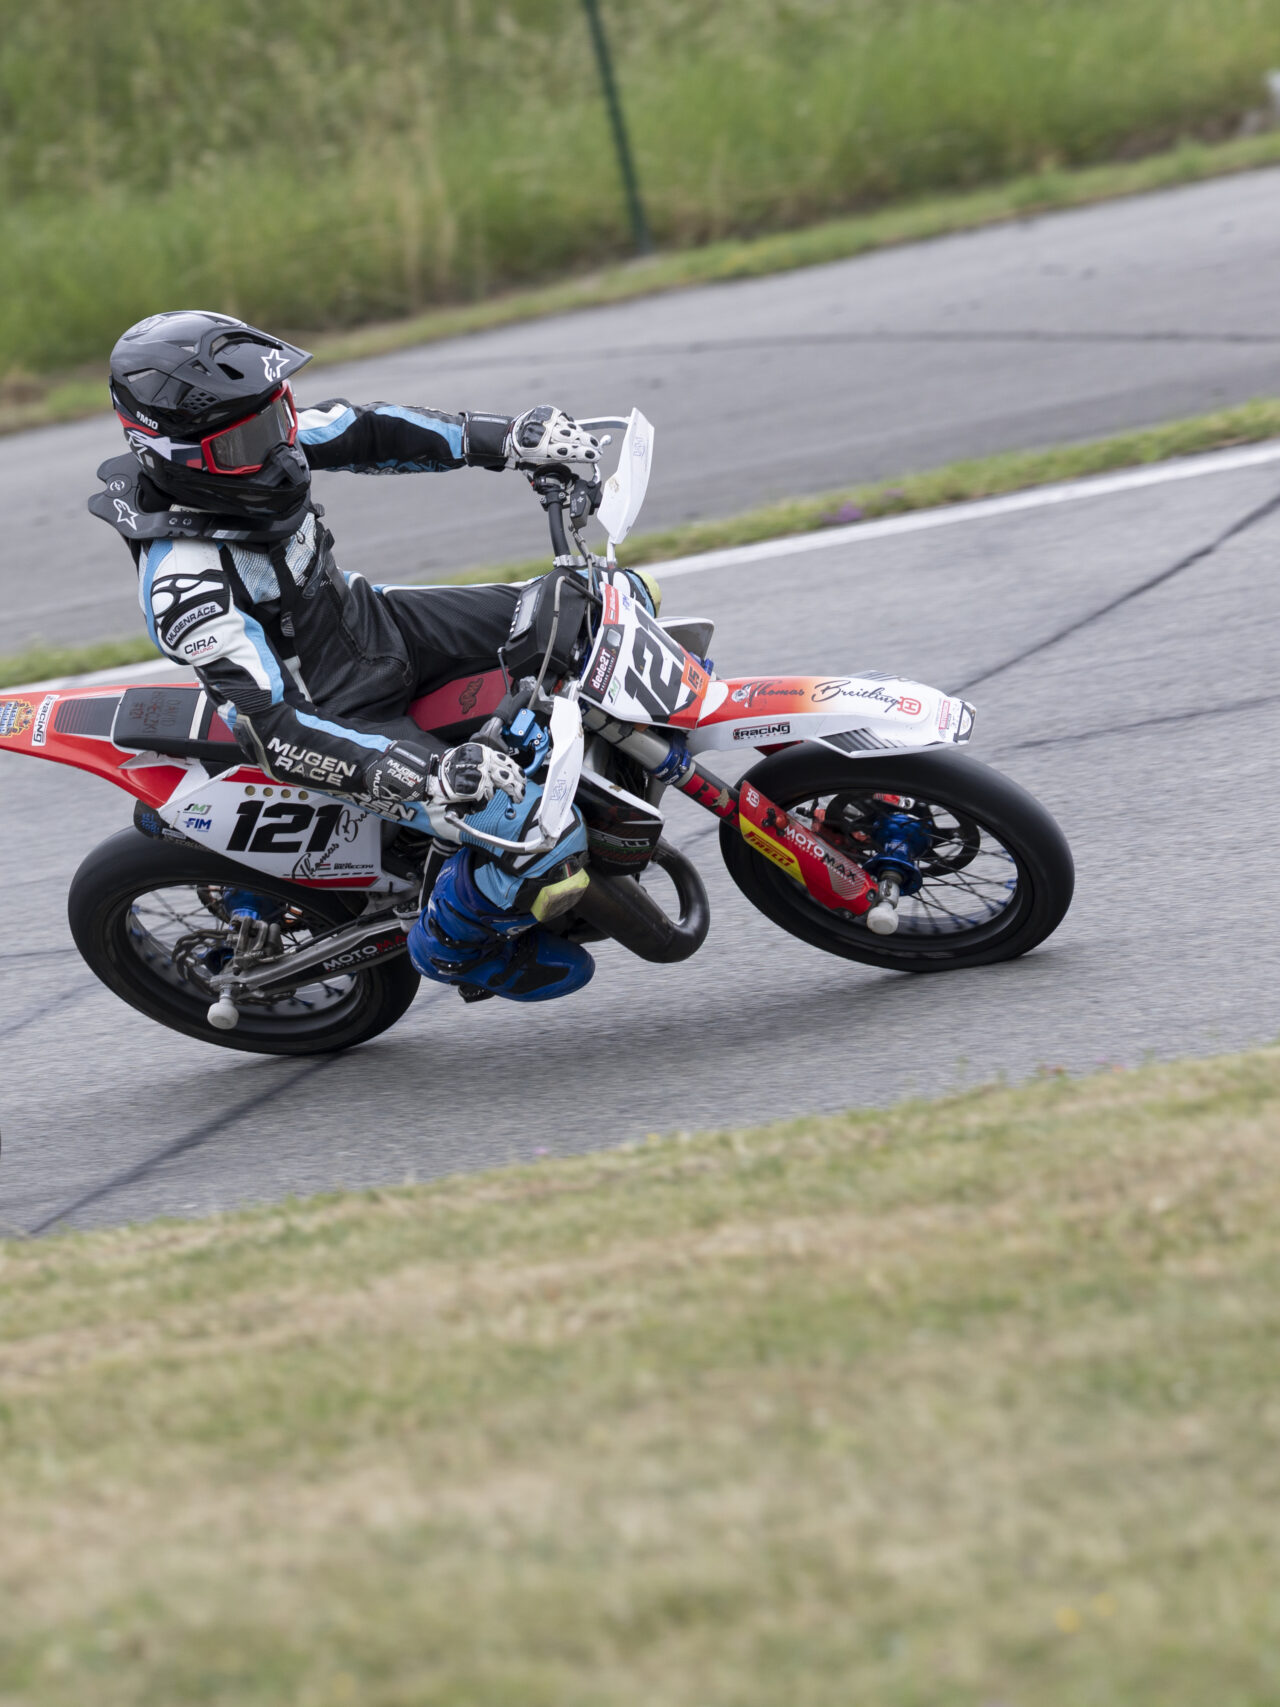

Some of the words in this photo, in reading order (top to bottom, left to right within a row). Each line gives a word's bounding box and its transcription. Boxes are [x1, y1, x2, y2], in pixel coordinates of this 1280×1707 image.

[167, 604, 217, 643] MUGENRACE
[184, 636, 217, 654] CIRA
[591, 649, 611, 689] dede2T
[687, 663, 702, 690] 15
[742, 680, 805, 707] Thomas
[812, 680, 899, 713] Breitling
[267, 737, 357, 777] MUGEN
[274, 755, 344, 787] RACE
[387, 759, 423, 783] MUGEN
[373, 769, 382, 798] MUG
[387, 768, 416, 788] RACE
[183, 817, 212, 830] FIM
[226, 800, 344, 853] 121
[744, 830, 795, 867] PIRELLI
[785, 826, 857, 882] MOTOMAX
[322, 935, 408, 972] MOTOMA
